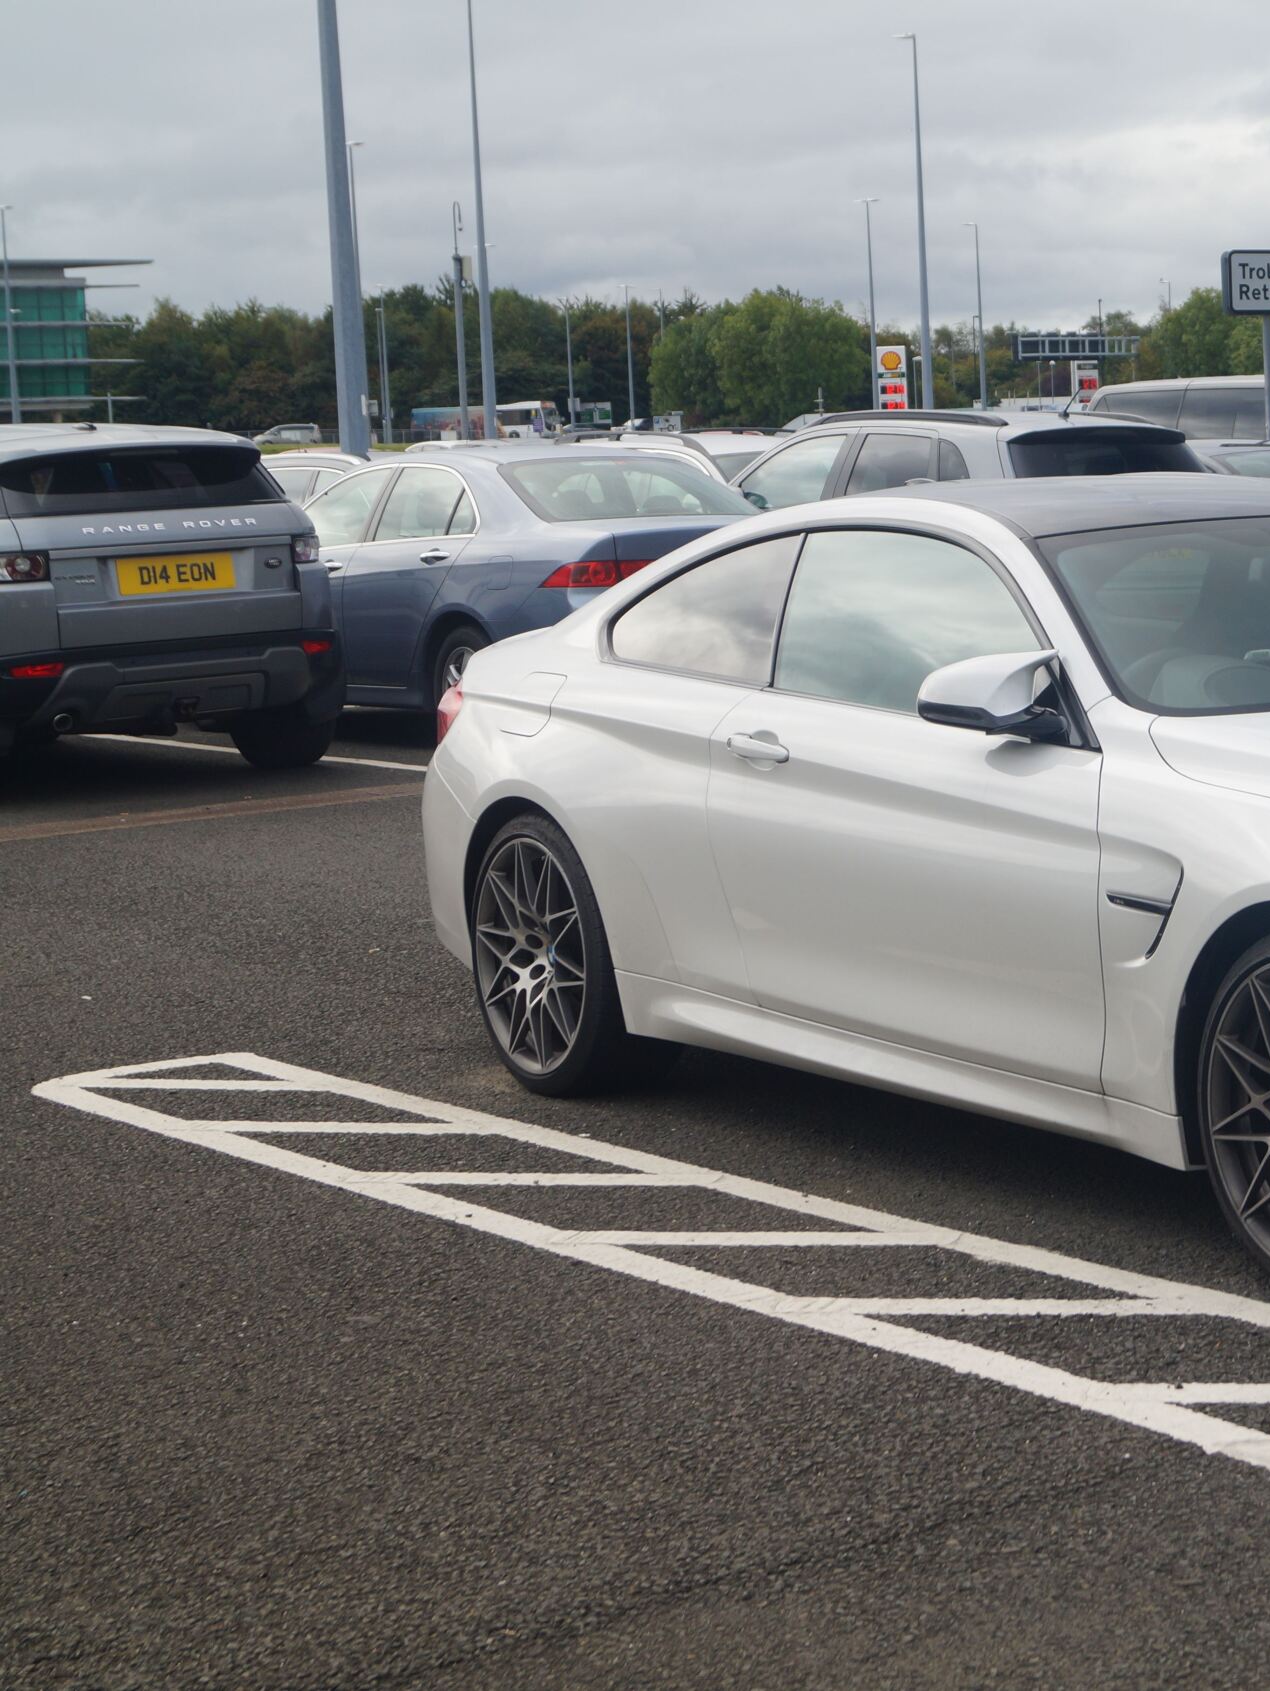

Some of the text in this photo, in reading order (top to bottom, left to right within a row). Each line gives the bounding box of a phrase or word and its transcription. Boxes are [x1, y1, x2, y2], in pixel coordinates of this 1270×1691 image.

[82, 517, 258, 535] RANGE ROVER
[138, 560, 217, 586] D14 EON
